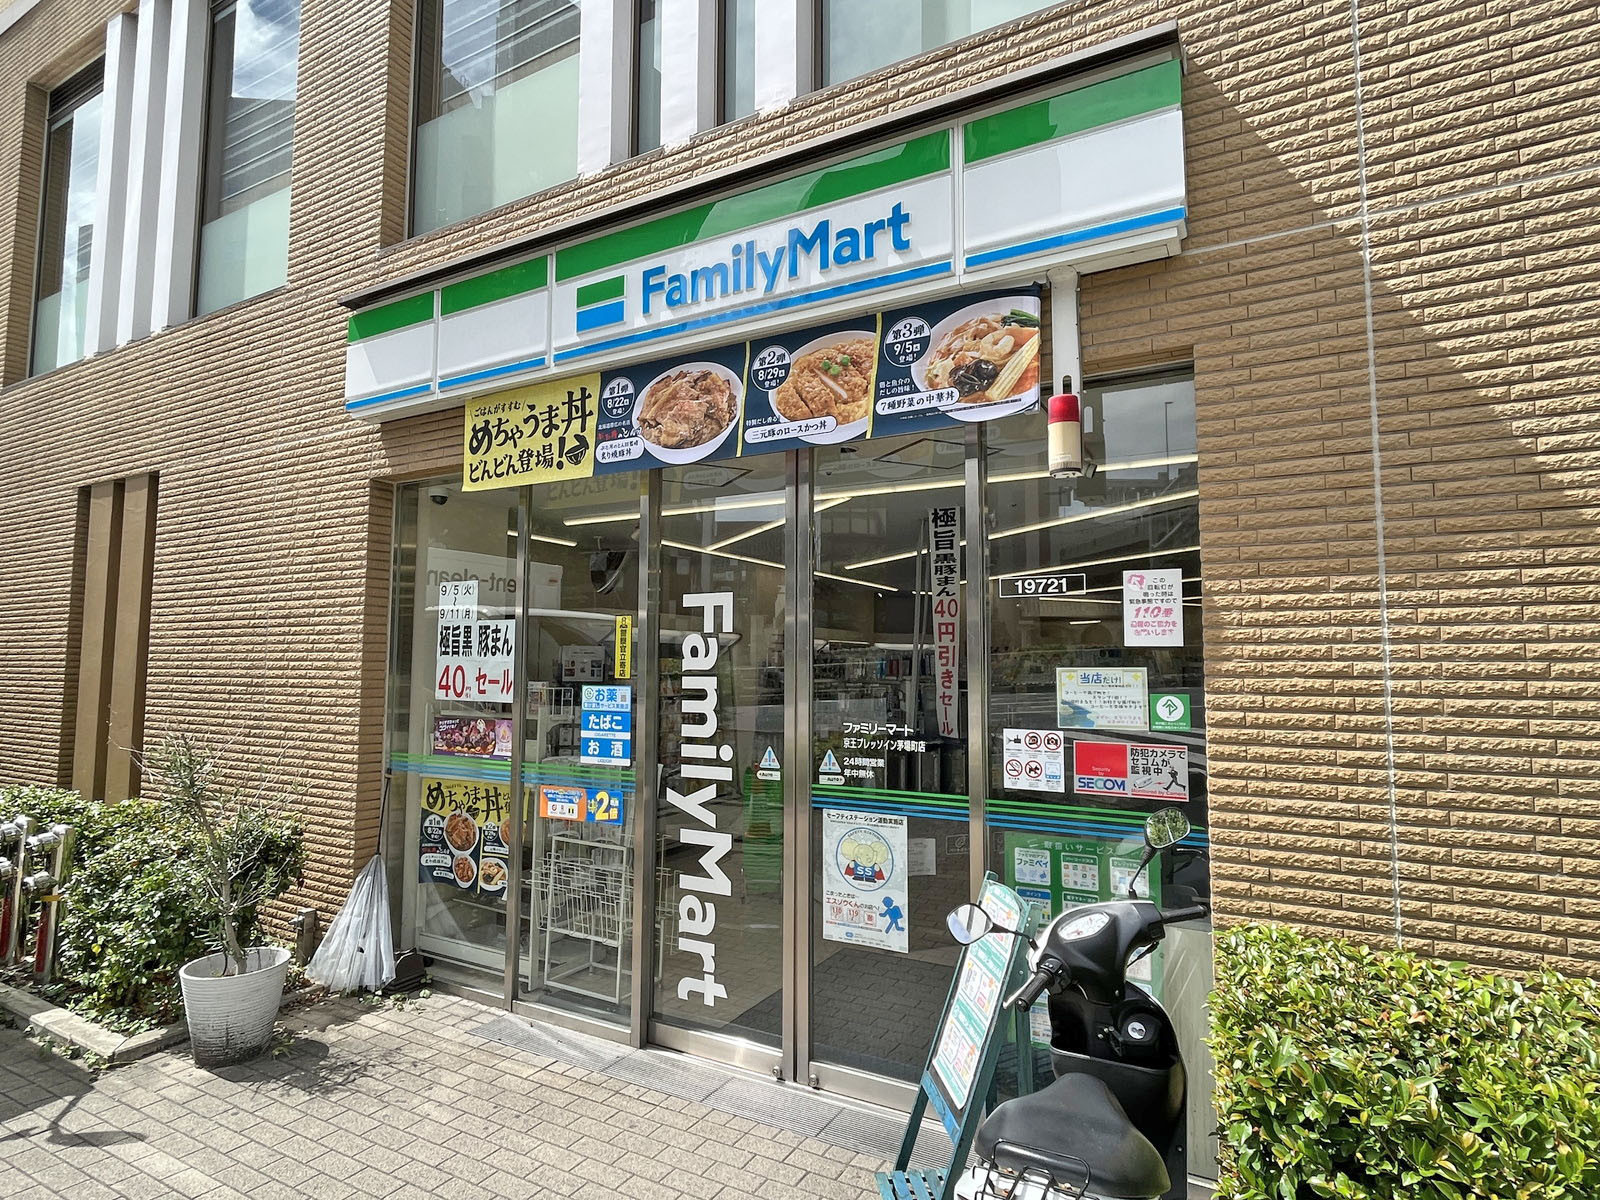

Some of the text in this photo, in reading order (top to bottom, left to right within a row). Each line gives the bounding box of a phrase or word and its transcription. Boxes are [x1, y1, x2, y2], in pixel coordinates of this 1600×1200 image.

[641, 200, 912, 316] FamilyMart
[892, 322, 925, 341] 第3弾
[879, 390, 956, 411] 7種野菜の中華丼
[474, 401, 522, 417] ごはんがすすむ
[469, 387, 594, 455] めちゃうま丼
[751, 419, 828, 440] 三元豚のロースかつ丼
[469, 436, 566, 483] どんどん登場!
[440, 584, 475, 596] 9/5(火)
[1014, 578, 1068, 594] 19721
[439, 608, 474, 620] 9/11(月)
[1134, 606, 1174, 618] 110番
[1080, 672, 1122, 684] 当店だけ!
[588, 713, 623, 730] たばこ
[842, 722, 914, 737] ファミリーマート
[1130, 748, 1186, 760] 防犯カメラで
[843, 757, 885, 768] 24時間営業
[1131, 758, 1171, 768] セコムが
[843, 768, 875, 779] 年中無休
[1131, 766, 1163, 776] 監視中
[1078, 777, 1126, 791] SECOM
[426, 781, 504, 822] めちゃうま丼
[666, 591, 734, 1008] FamilyMart
[1016, 857, 1049, 868] ファミペイ
[856, 866, 873, 875] SS
